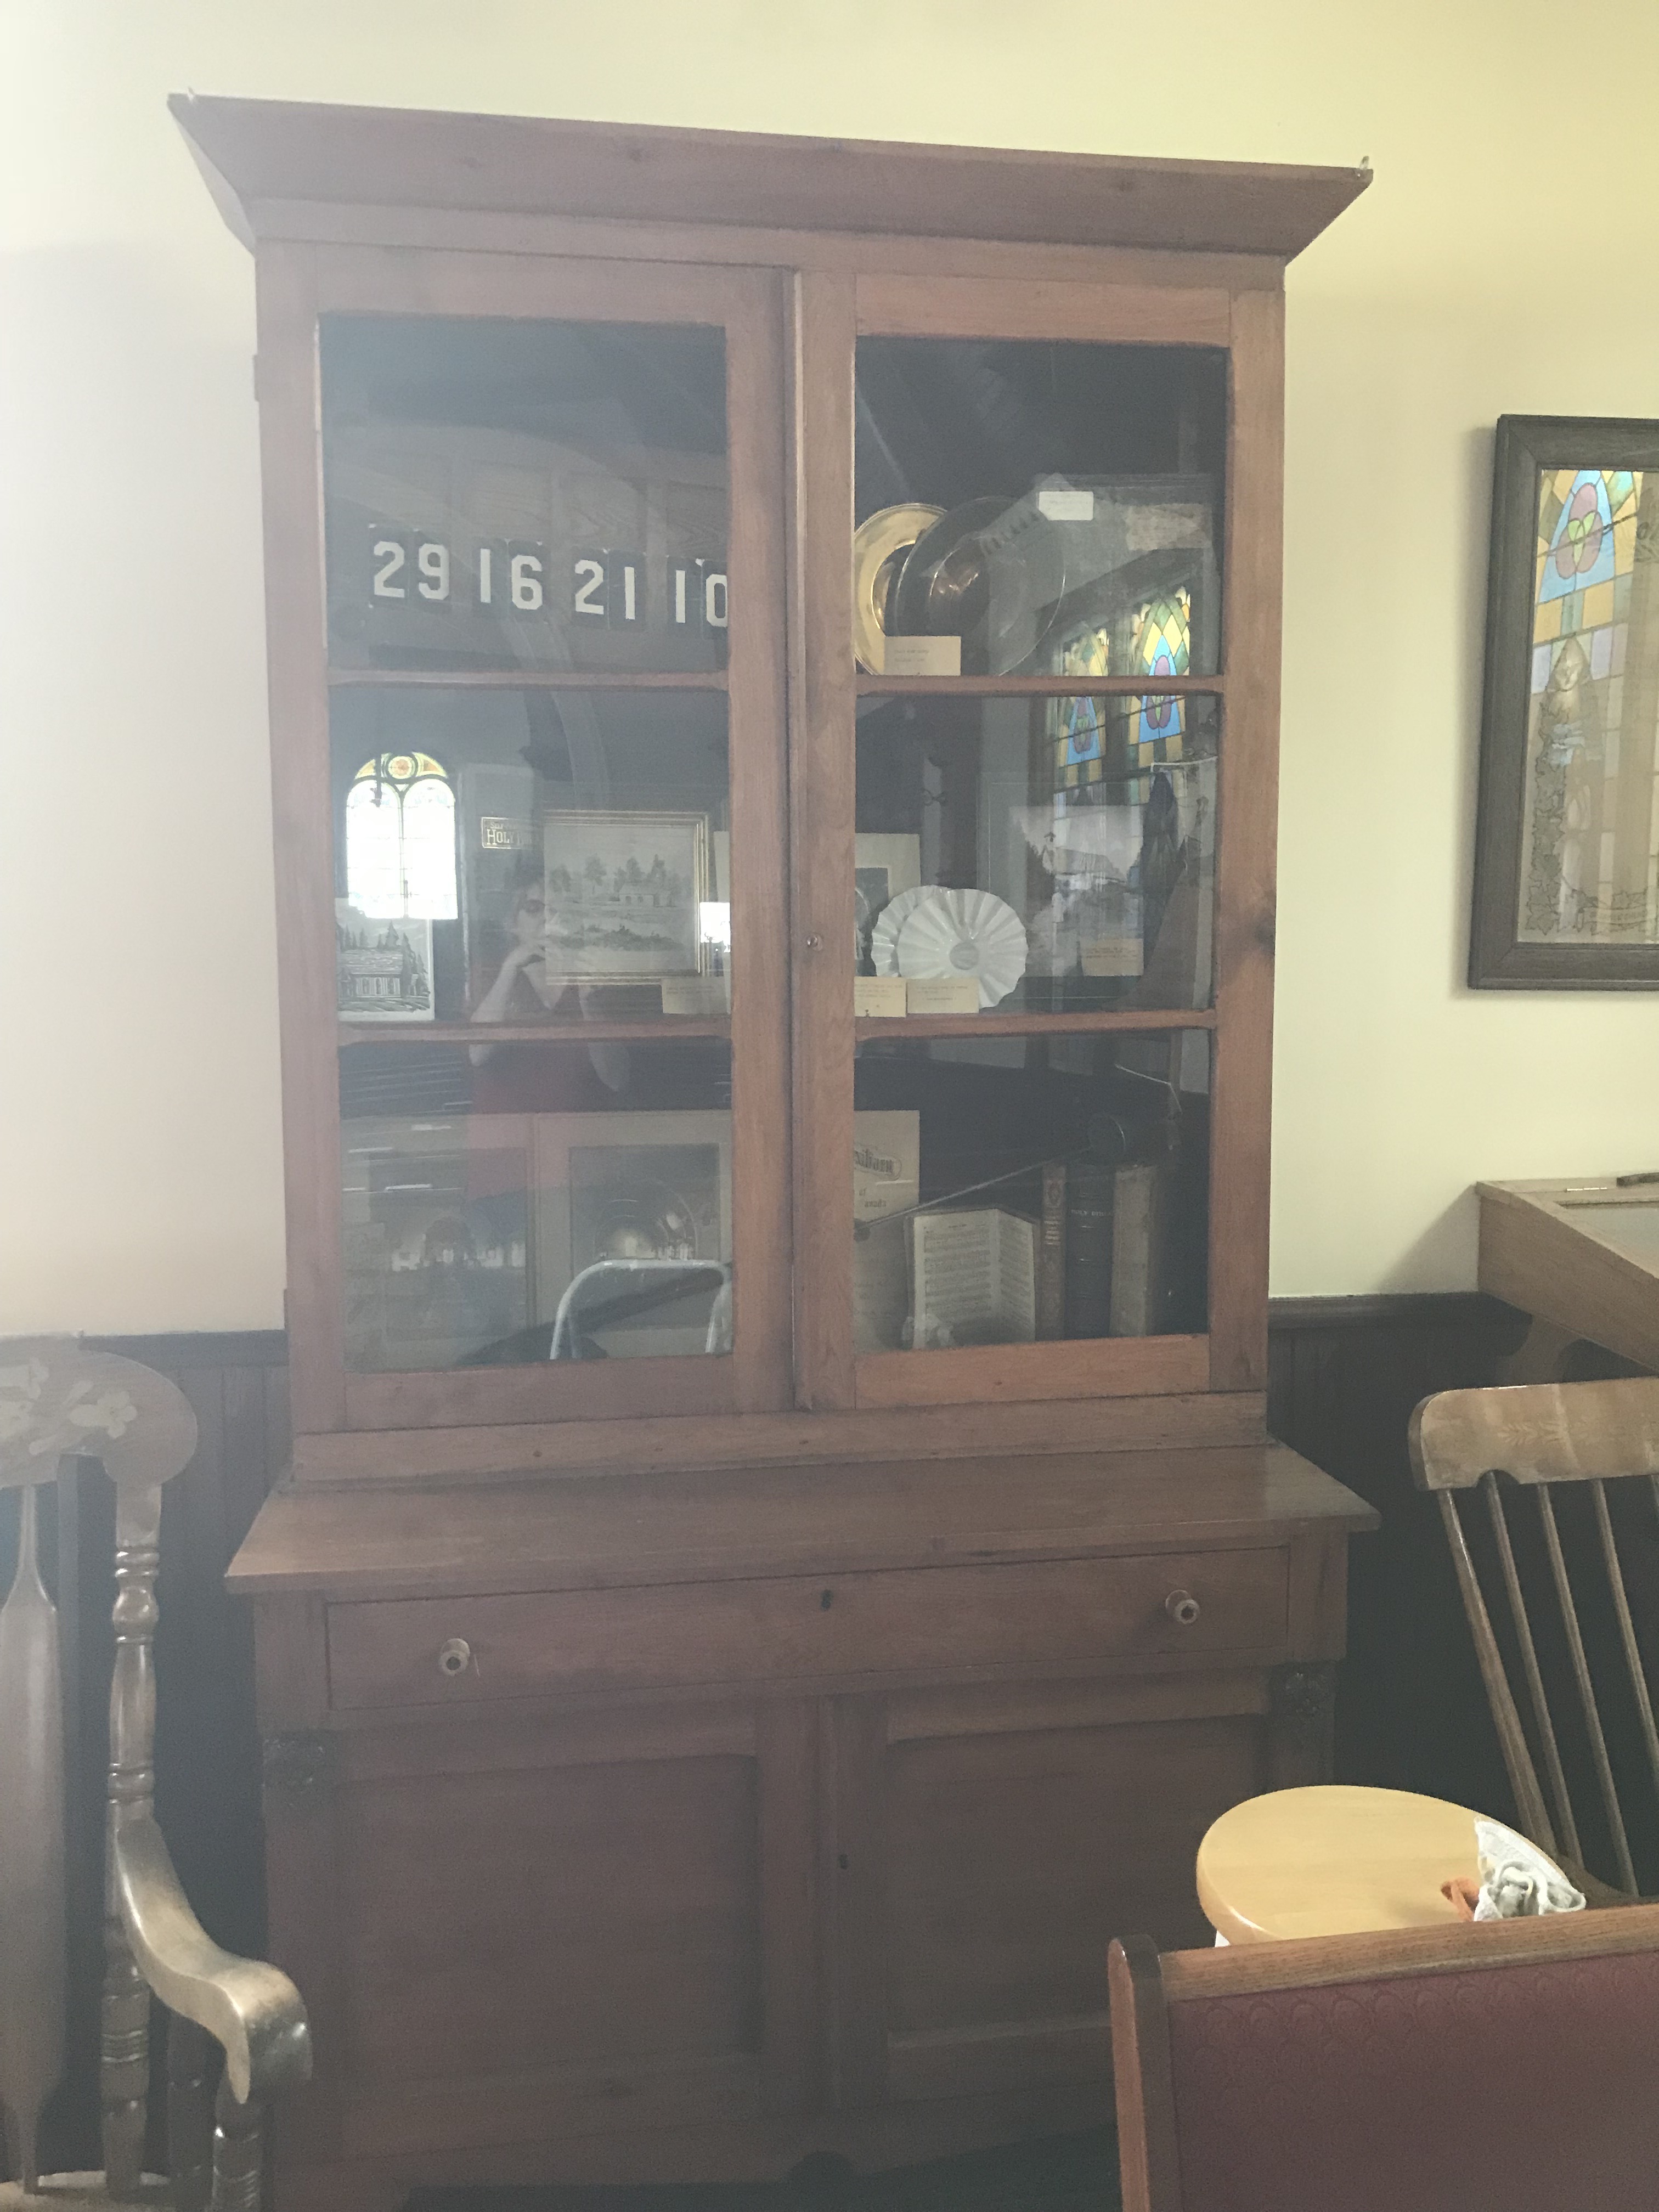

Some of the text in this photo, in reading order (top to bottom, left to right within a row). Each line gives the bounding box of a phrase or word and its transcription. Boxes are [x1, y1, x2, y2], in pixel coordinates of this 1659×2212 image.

[373, 540, 729, 628] 29 16 21 10
